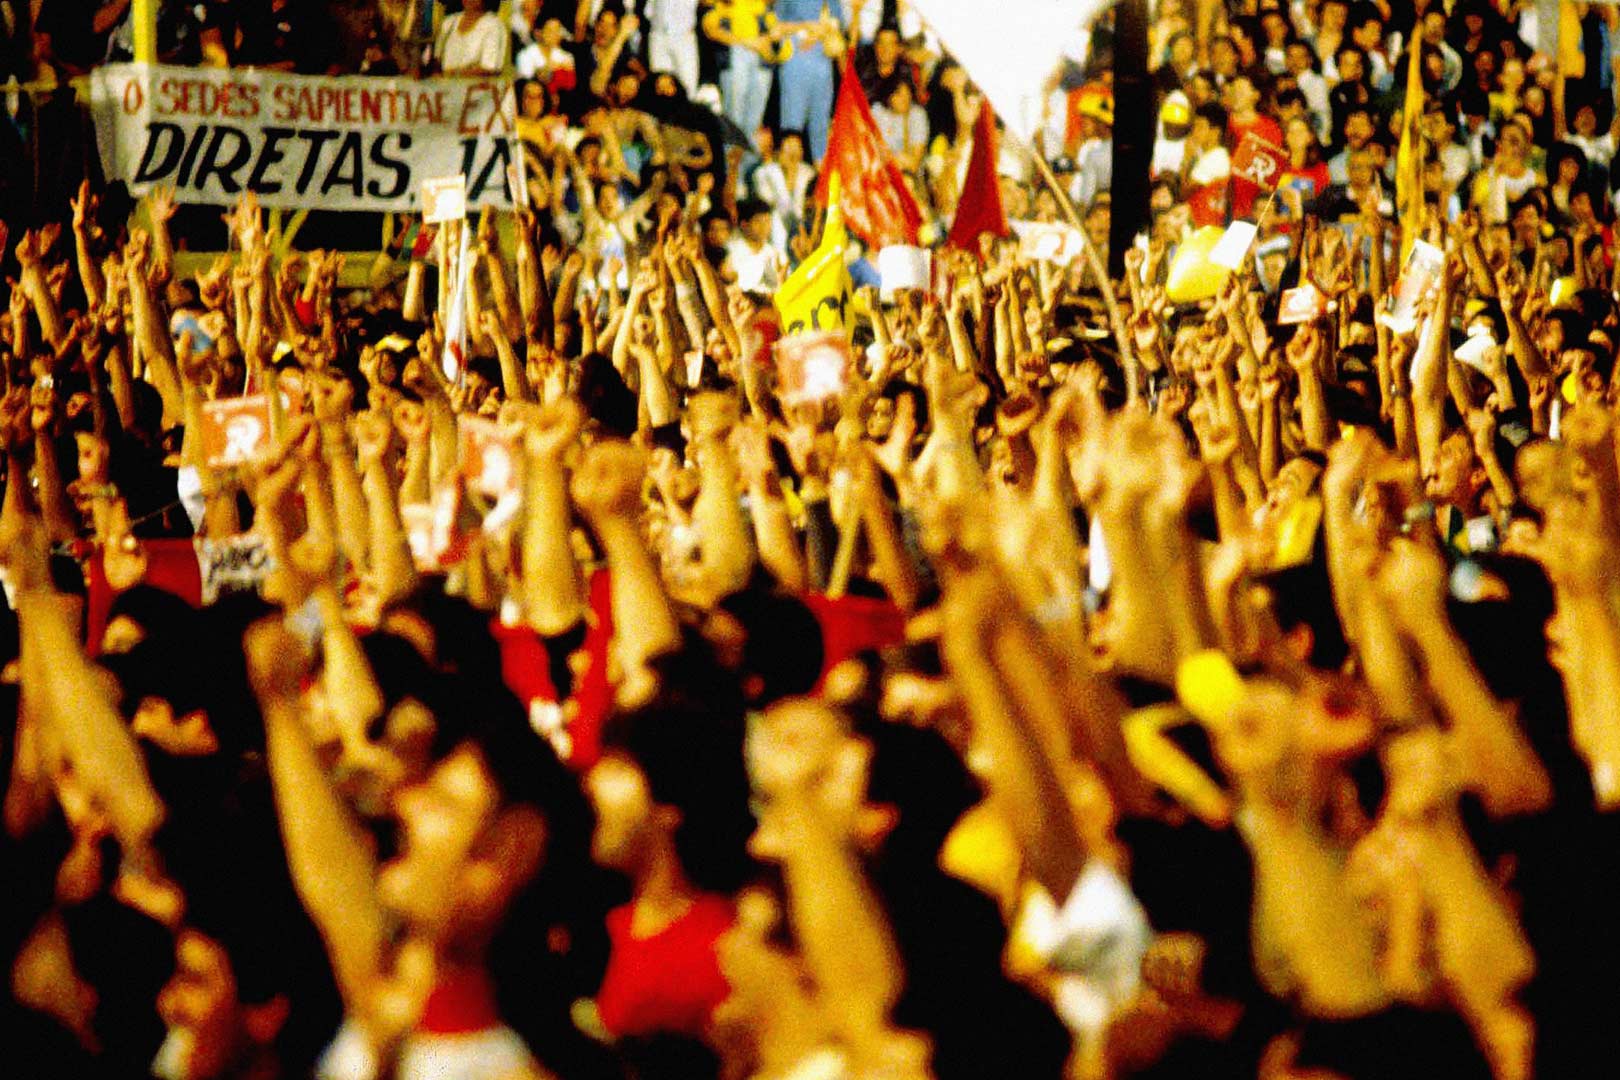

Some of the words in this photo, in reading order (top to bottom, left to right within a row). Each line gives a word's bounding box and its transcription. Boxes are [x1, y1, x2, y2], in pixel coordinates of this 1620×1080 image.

[123, 79, 143, 116] O
[157, 79, 260, 117] SEDES
[273, 83, 447, 124] SAPIENTIAE
